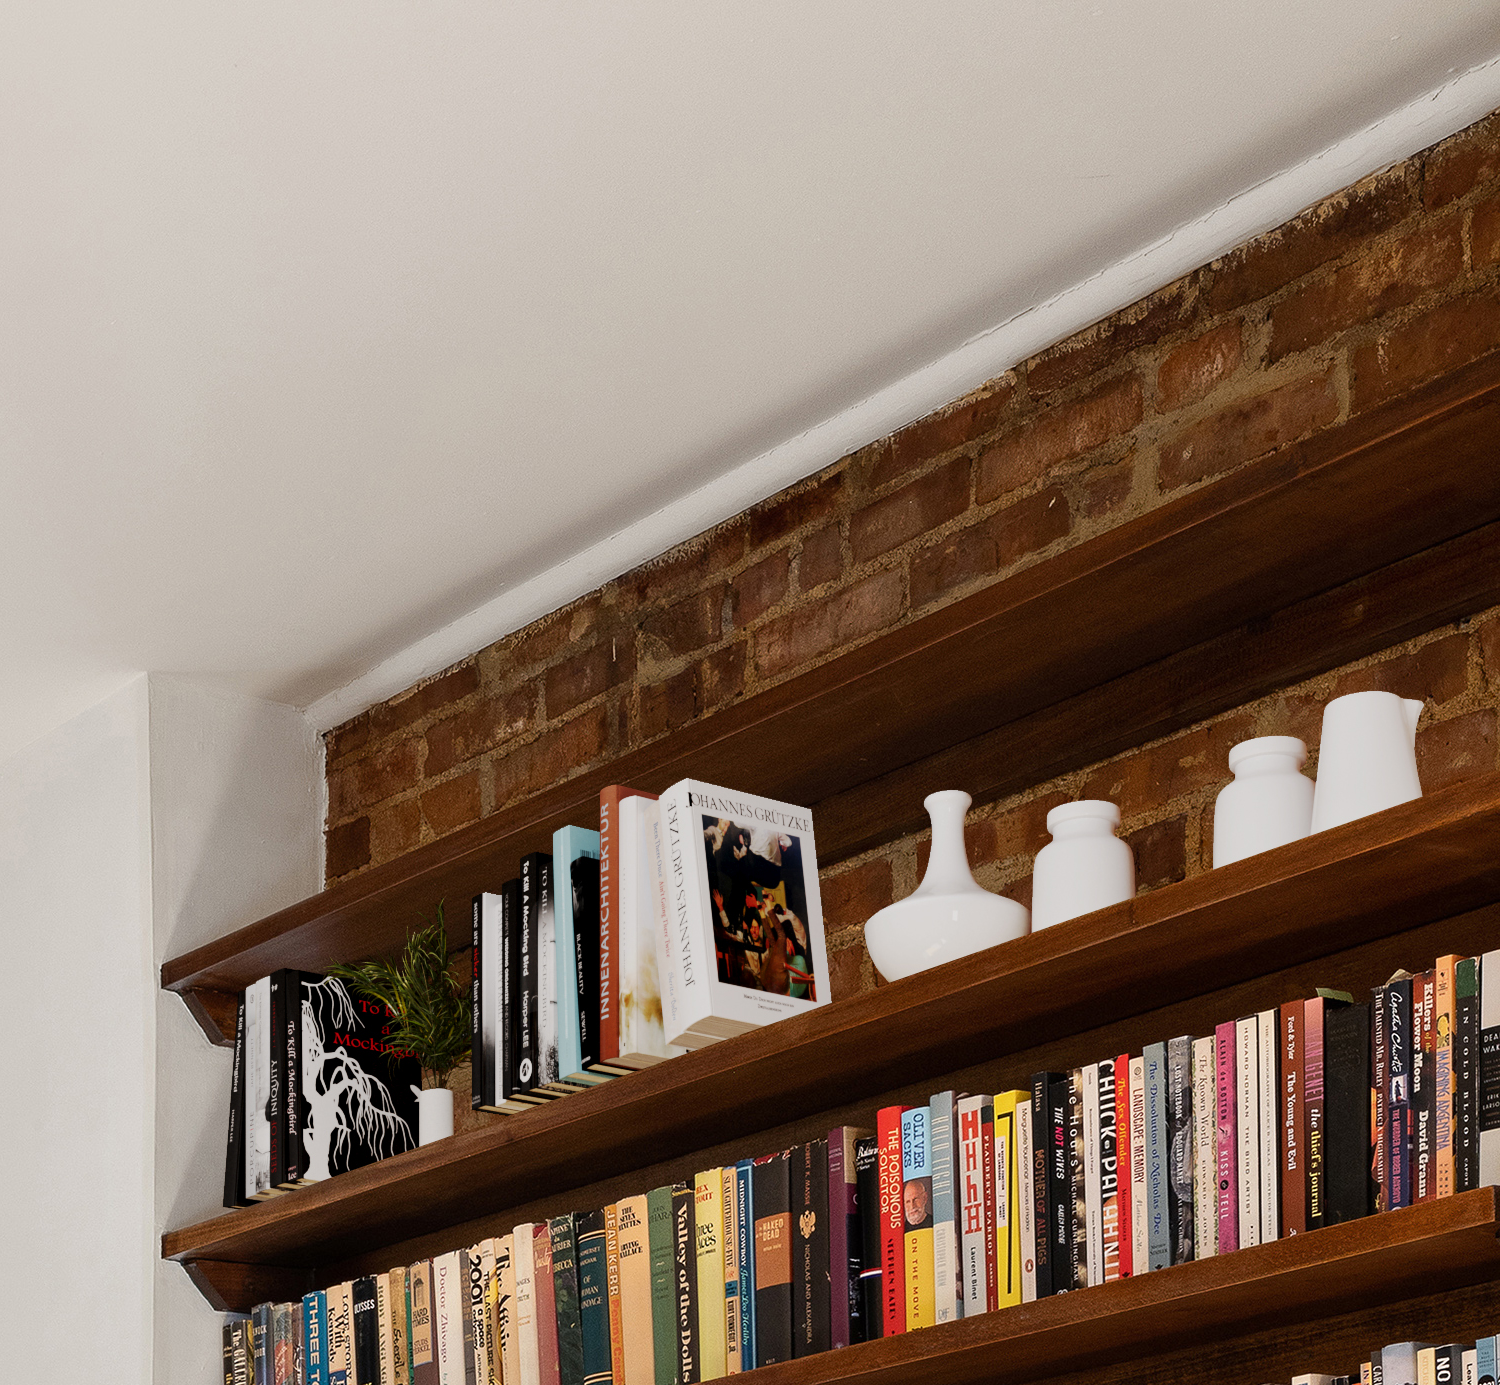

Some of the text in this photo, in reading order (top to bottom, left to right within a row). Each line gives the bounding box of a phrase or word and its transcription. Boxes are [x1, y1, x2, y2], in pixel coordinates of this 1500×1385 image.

[523, 861, 529, 873] To
[601, 803, 609, 1020] INNENARCHITEKTUR
[288, 1021, 294, 1035] To
[359, 1000, 379, 1014] To
[381, 1026, 390, 1035] a
[1424, 983, 1433, 1032] Killers
[1463, 1007, 1469, 1024] IN
[288, 1036, 296, 1058] Kill
[1414, 1003, 1423, 1092] Flower Moon
[287, 1068, 297, 1135] Mockingbird
[1286, 1071, 1297, 1171] The Young and Evil
[1310, 1108, 1320, 1130] the
[903, 1122, 912, 1168] SACKS
[913, 1113, 925, 1169] OLIVER
[1418, 1111, 1429, 1198] David Grann
[879, 1148, 890, 1214] SOLICITOR
[888, 1128, 901, 1229] THE POISONOUS
[1134, 1147, 1144, 1184] MEMORY
[1220, 1150, 1229, 1219] KISS TELL
[1310, 1170, 1322, 1218] journal
[606, 1210, 616, 1251] JEAN
[470, 1254, 483, 1305] 2001
[608, 1254, 619, 1295] KERR
[677, 1202, 691, 1384] Valley of the Dolls
[308, 1297, 320, 1367] THREE
[611, 1300, 621, 1345] Penny
[1436, 1357, 1450, 1382] NO
